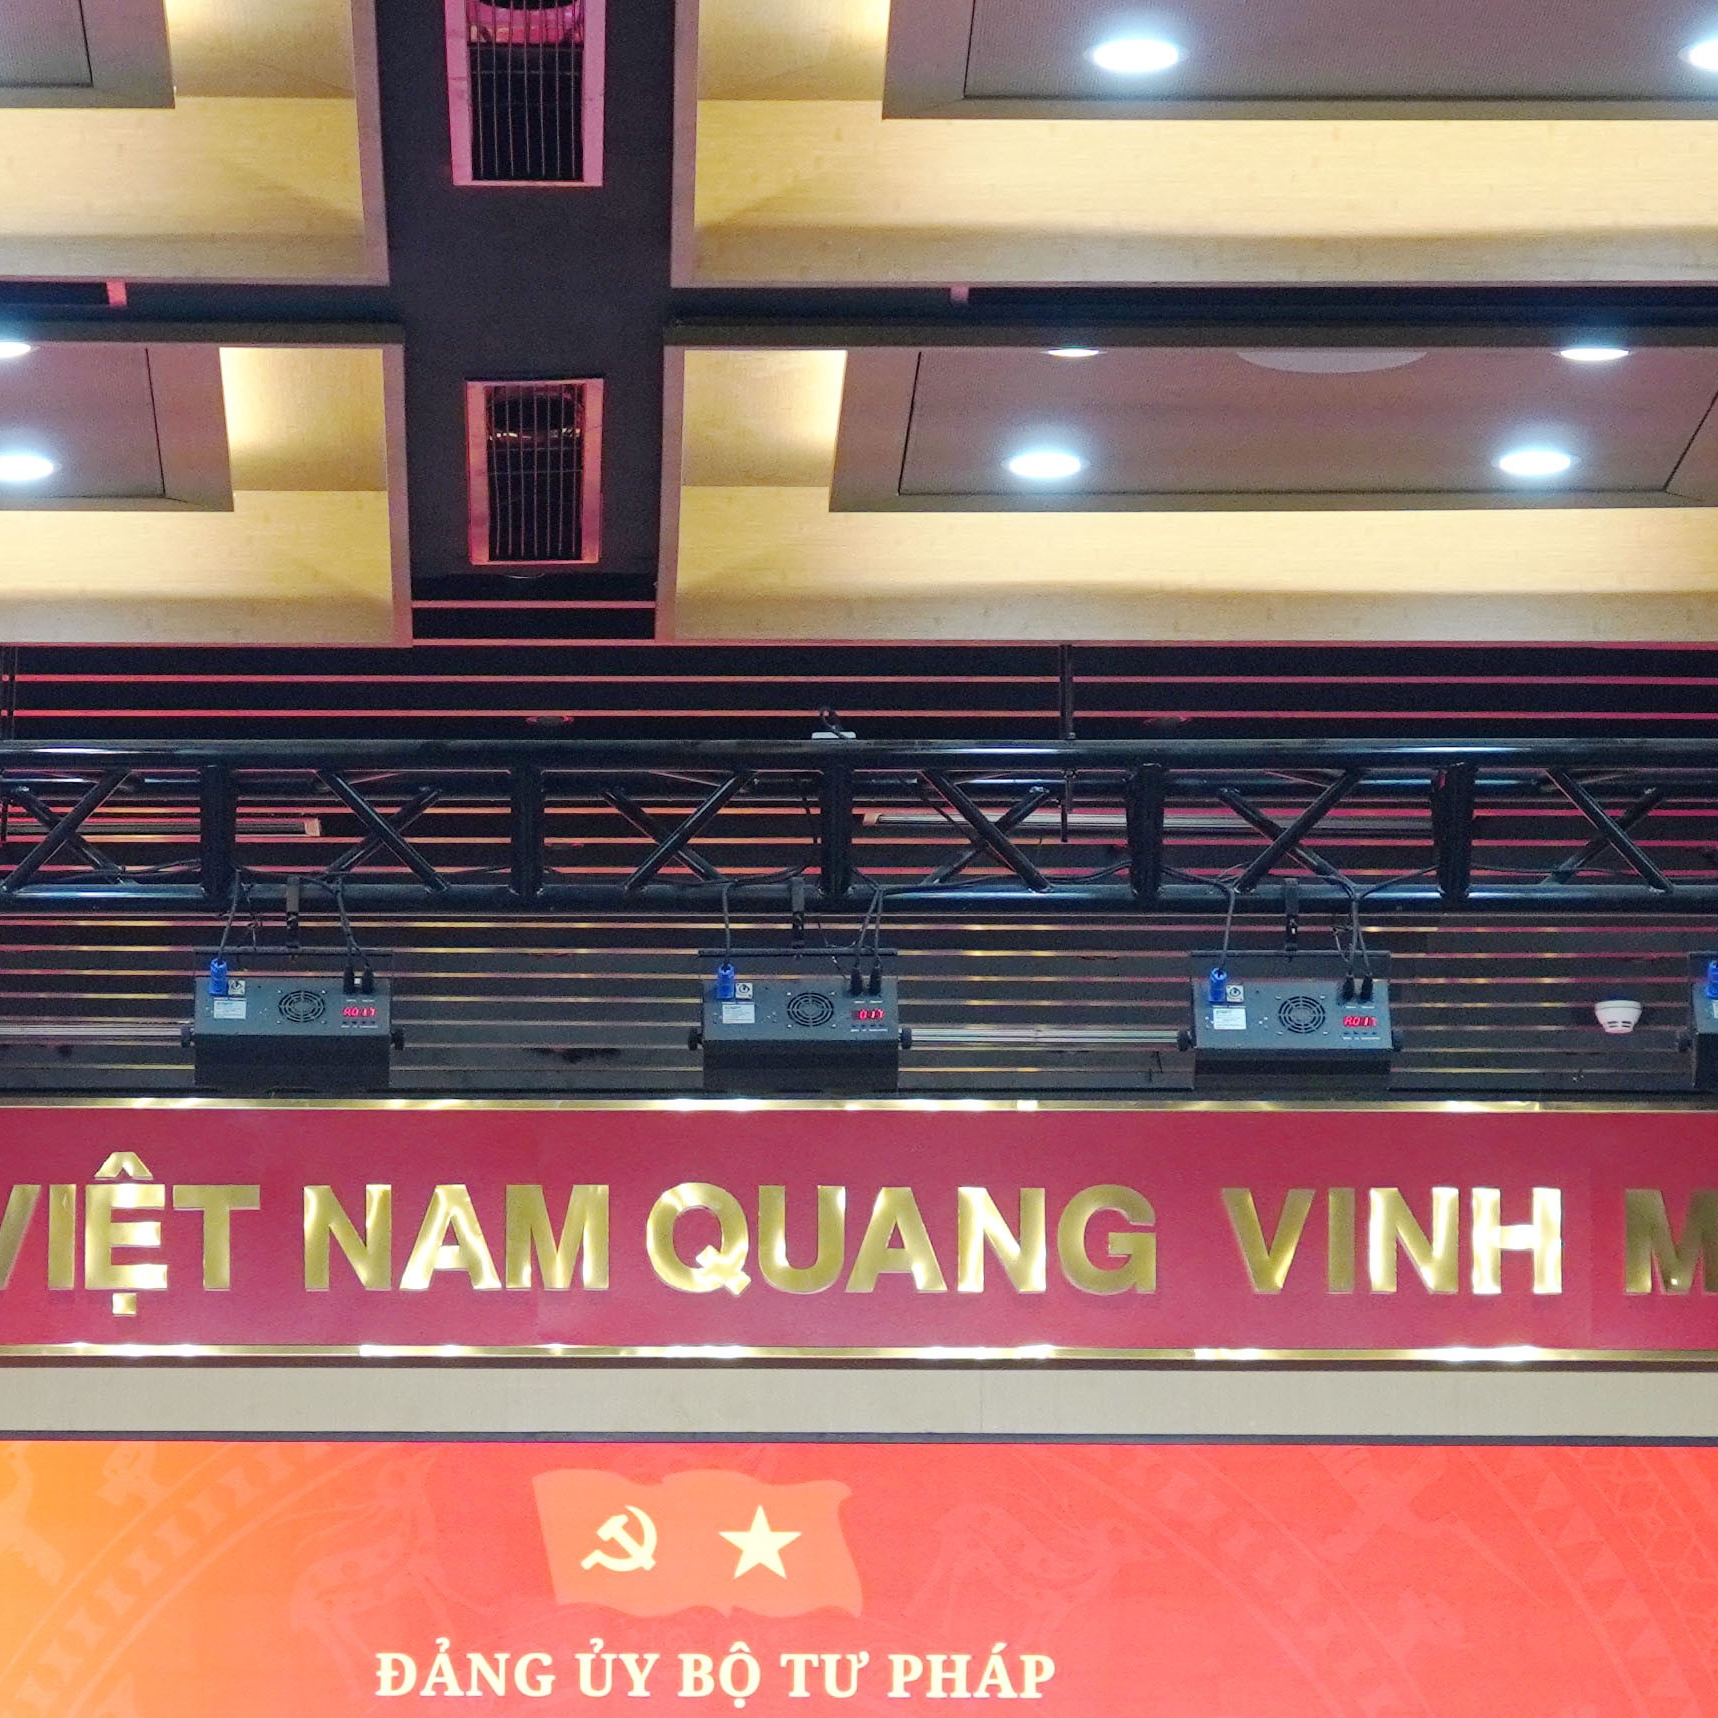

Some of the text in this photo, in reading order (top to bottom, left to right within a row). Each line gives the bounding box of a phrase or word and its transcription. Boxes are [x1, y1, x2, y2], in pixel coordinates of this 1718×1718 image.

[302, 1183, 609, 1291] NAM
[646, 1183, 1157, 1295] QUANG
[1221, 1186, 1563, 1294] VINH
[375, 1637, 1055, 1708] ĐẢNG ỦY BỘ TƯ PHÁP
